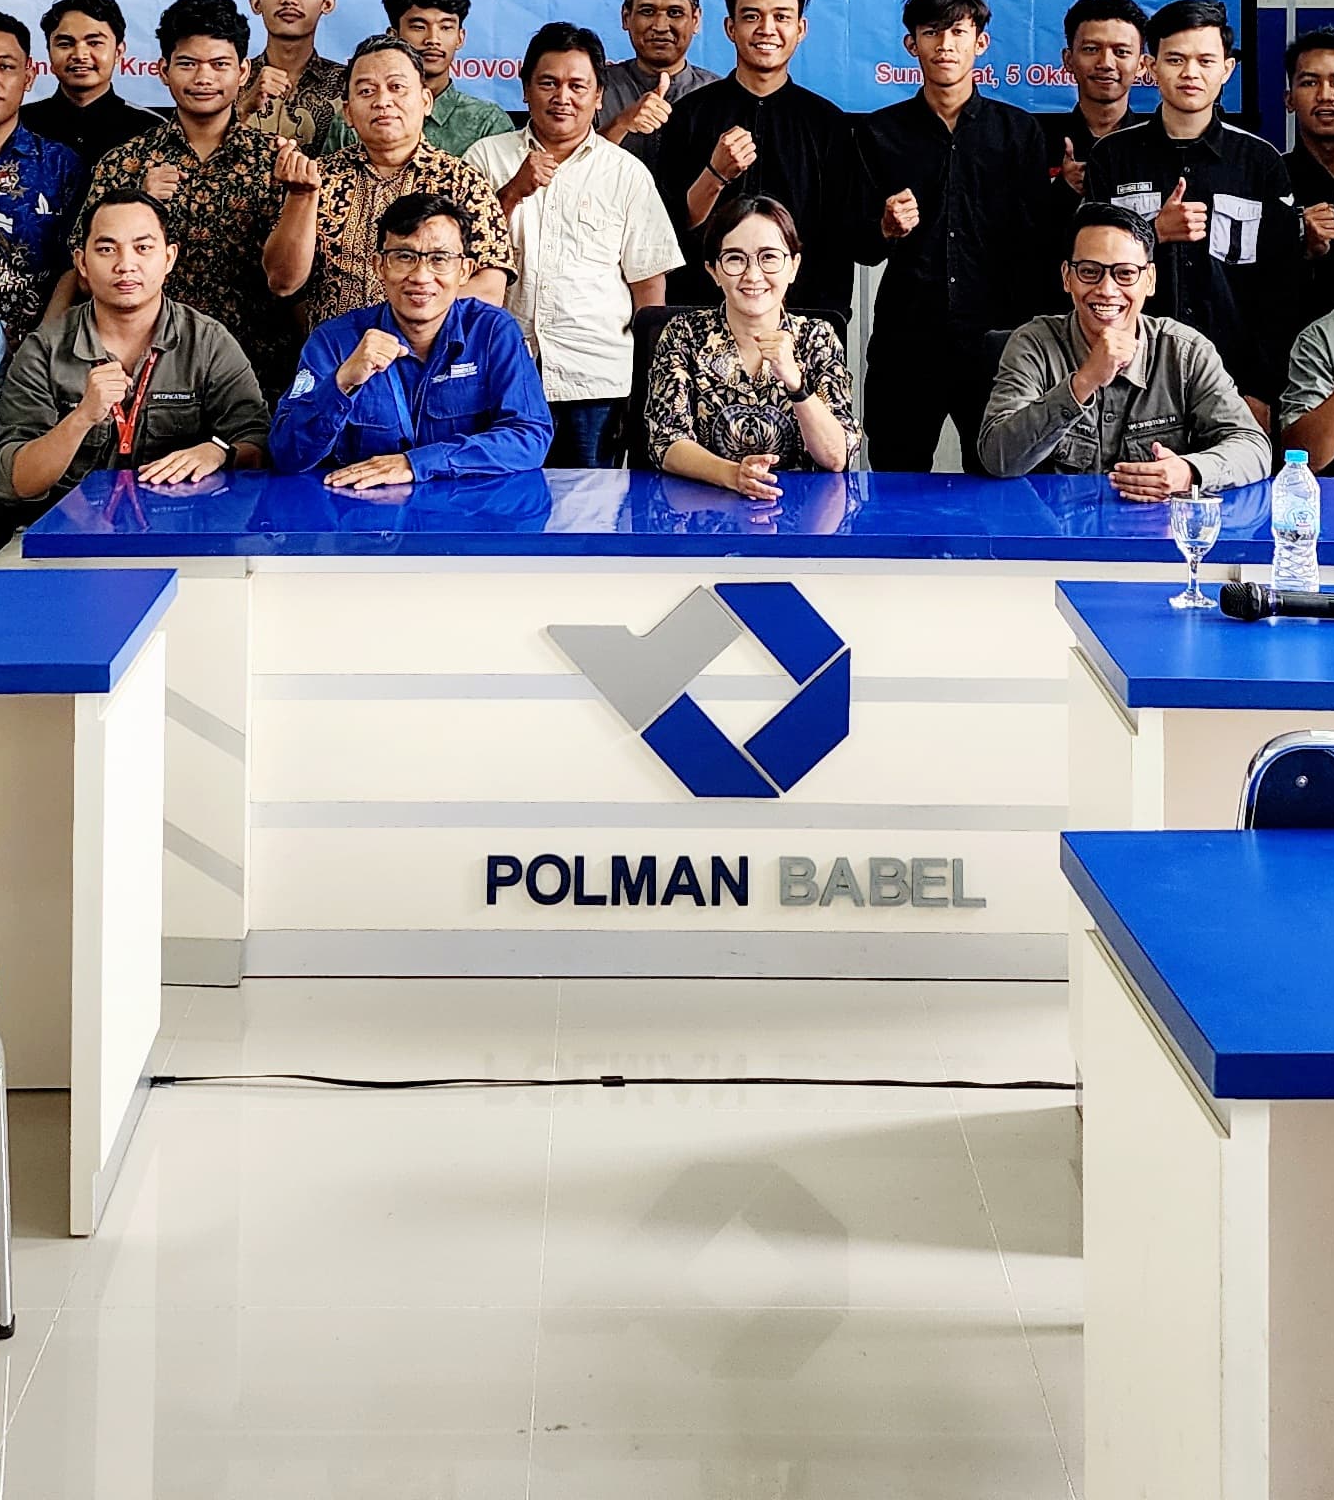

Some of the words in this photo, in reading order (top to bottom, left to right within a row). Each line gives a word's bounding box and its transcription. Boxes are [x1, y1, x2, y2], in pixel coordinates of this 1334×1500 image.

[1007, 65, 1021, 84] 5
[486, 853, 749, 907] POLMAN
[778, 855, 987, 909] BABEL
